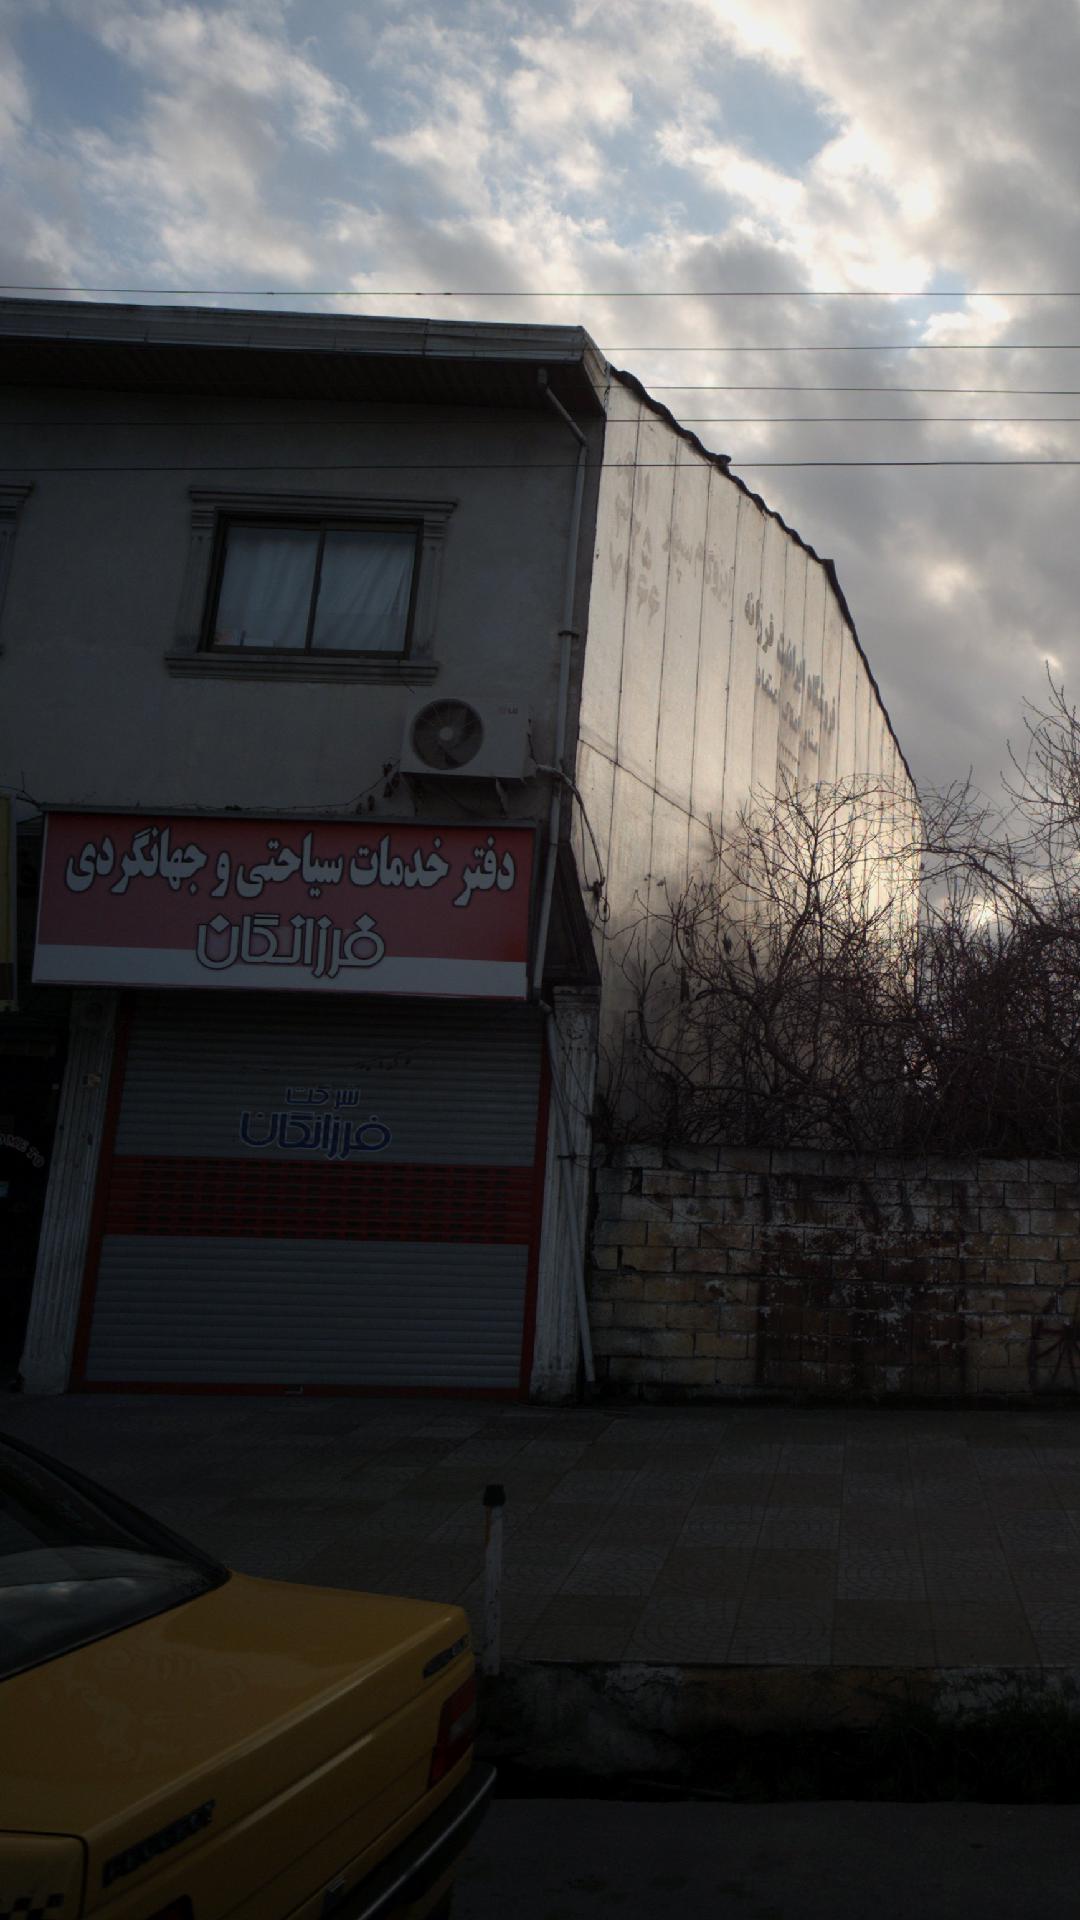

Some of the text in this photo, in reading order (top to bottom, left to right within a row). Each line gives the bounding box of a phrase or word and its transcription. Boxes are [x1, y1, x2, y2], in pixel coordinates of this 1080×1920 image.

[64, 825, 516, 908] دفتر خدمات سیاحتی و جهانگردی
[195, 912, 387, 979] فرزانگان
[239, 1111, 393, 1160] فرزانگان
